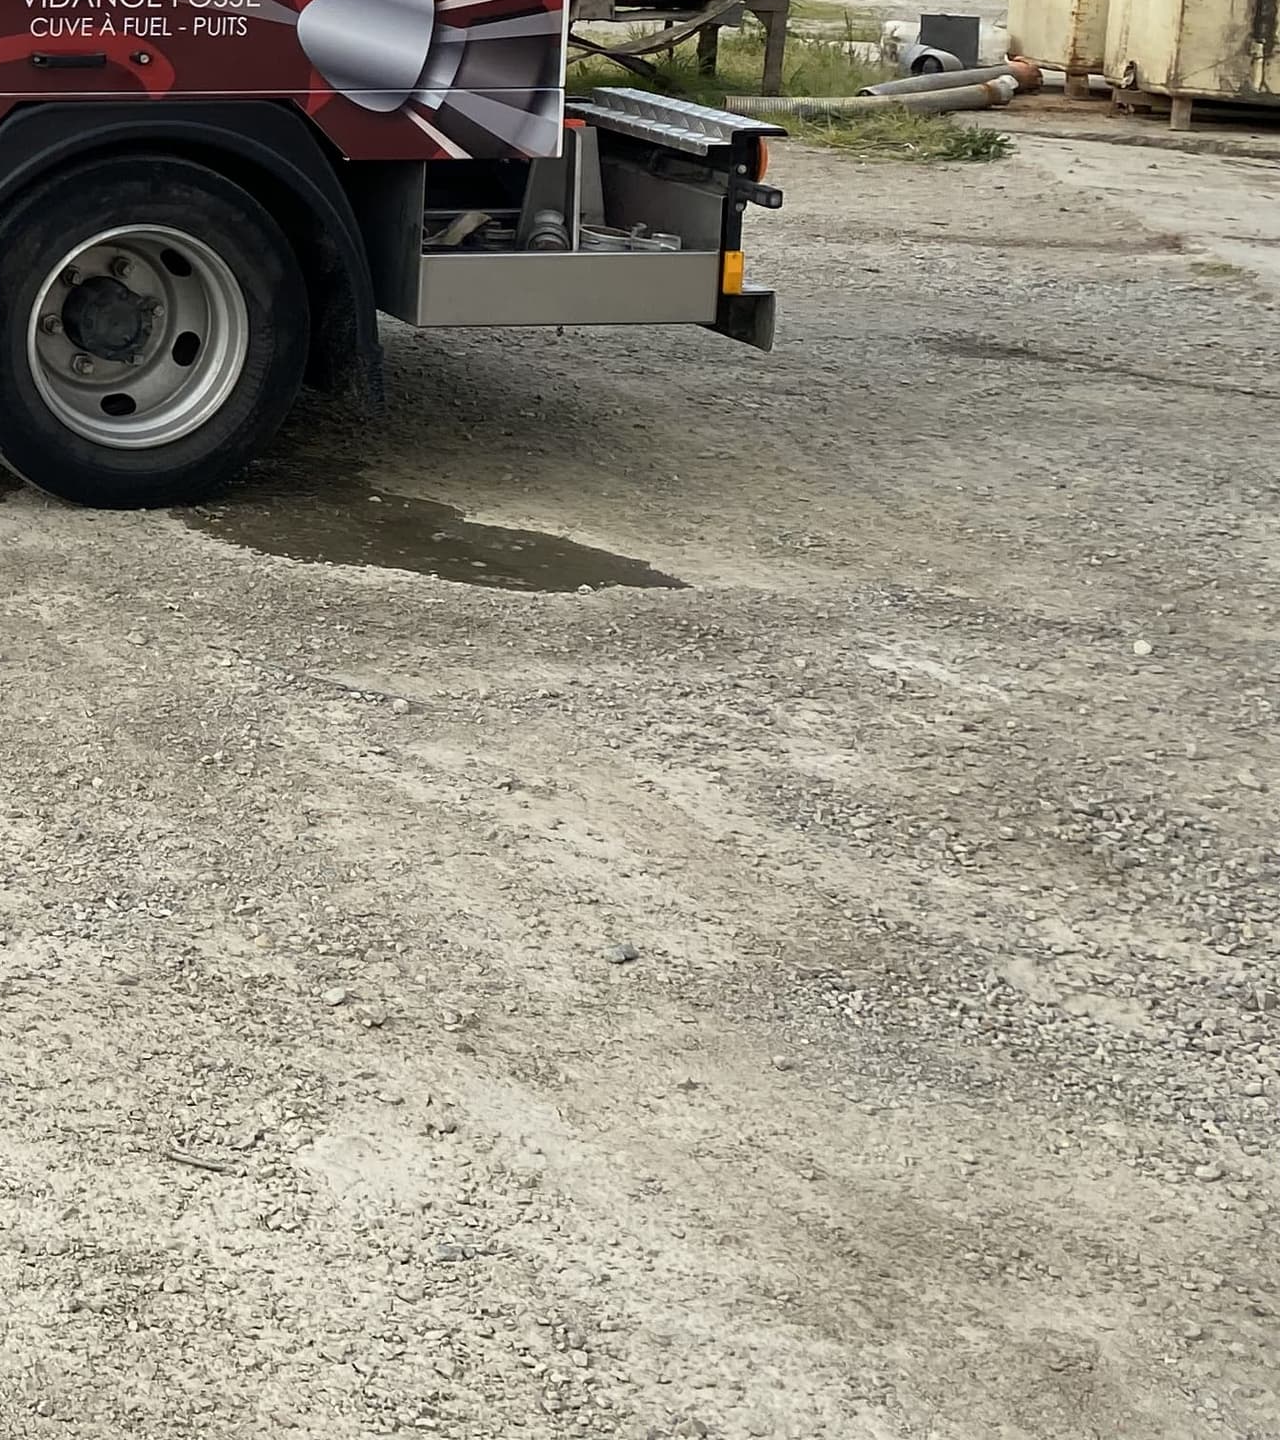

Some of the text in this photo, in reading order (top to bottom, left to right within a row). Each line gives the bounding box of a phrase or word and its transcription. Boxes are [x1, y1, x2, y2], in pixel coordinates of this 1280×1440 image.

[30, 17, 93, 37] CUVE
[99, 12, 117, 37] À
[123, 17, 172, 37] FUEL
[193, 16, 248, 37] PUITS
